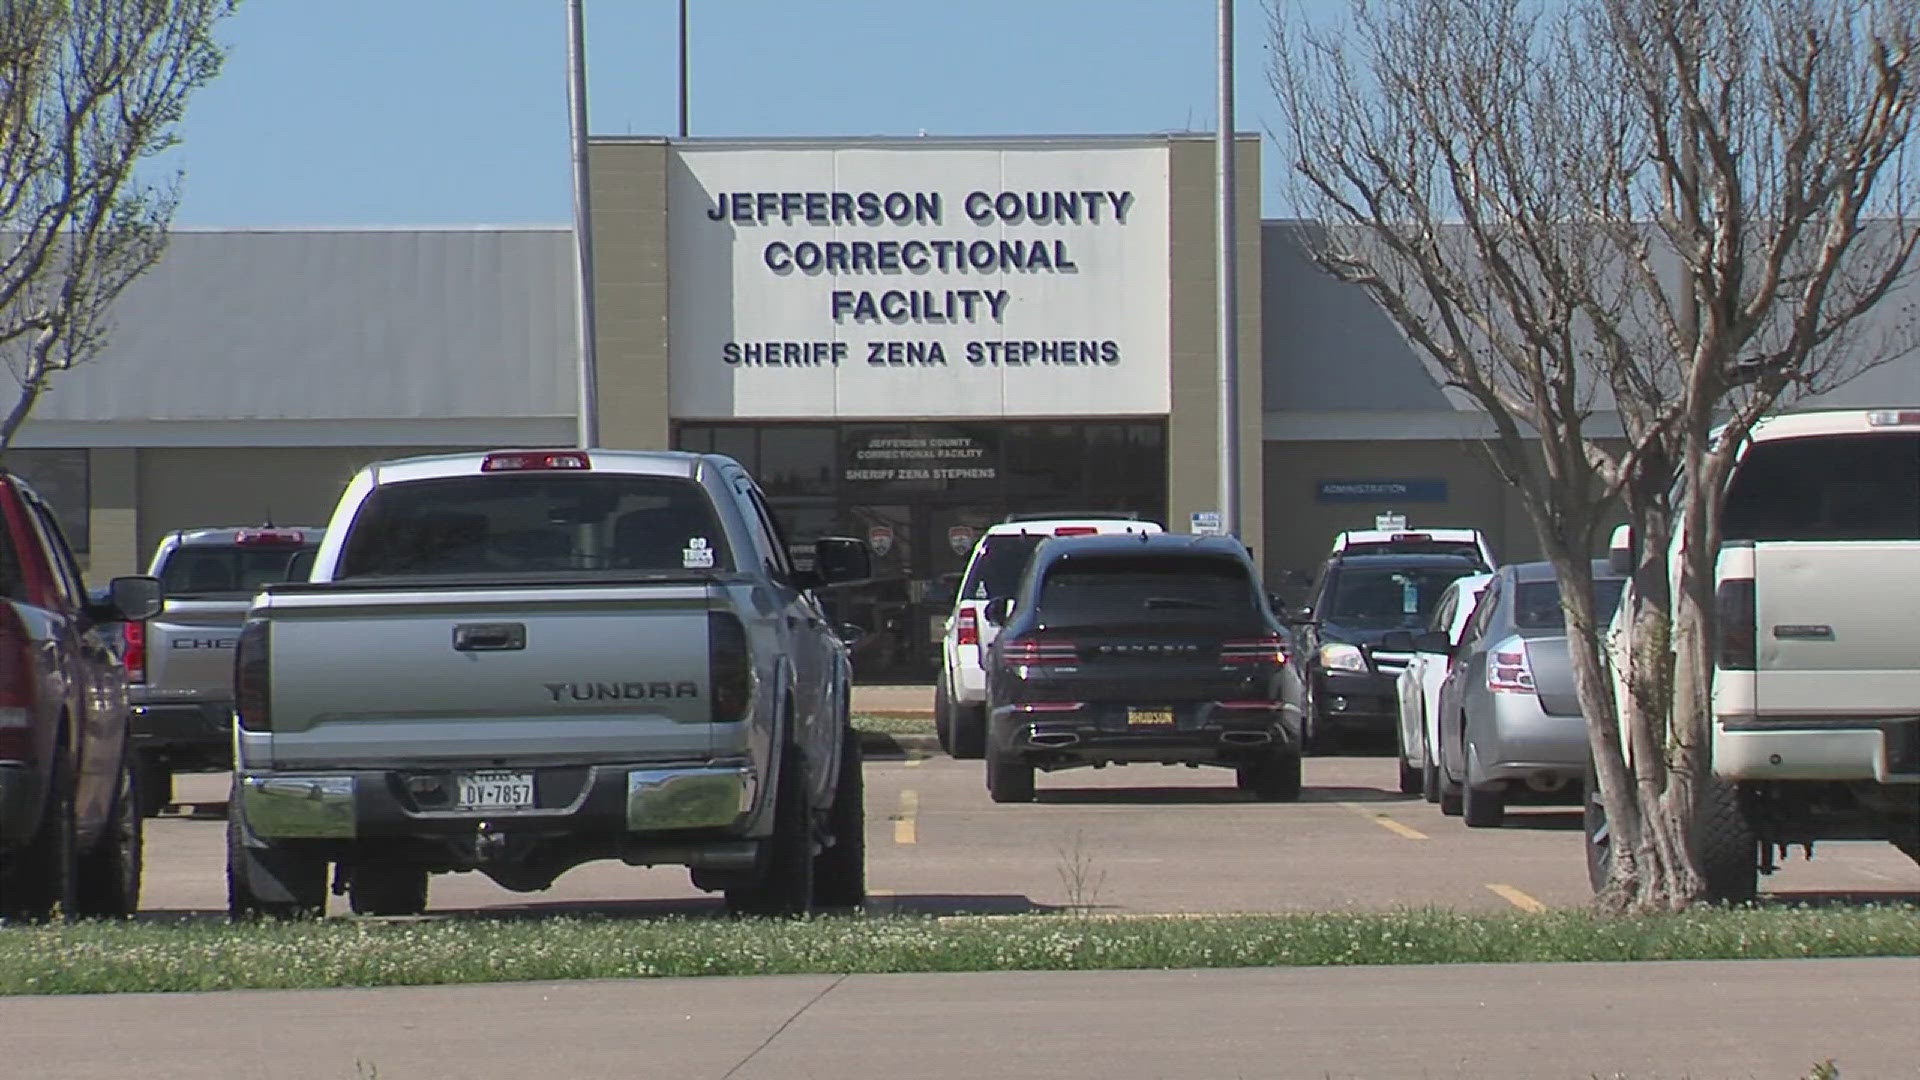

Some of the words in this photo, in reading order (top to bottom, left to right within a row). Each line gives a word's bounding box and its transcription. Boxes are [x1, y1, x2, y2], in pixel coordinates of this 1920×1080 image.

[707, 192, 941, 222] JEFFERSON
[964, 191, 1133, 220] COUNTY
[764, 240, 1075, 271] CORRECTIONAL
[832, 290, 1007, 320] FACILITY
[723, 342, 847, 365] SHERIFF
[867, 342, 946, 364] ZENA
[965, 341, 1119, 364] STEPHENS
[868, 438, 927, 448] JEFFERSON
[930, 438, 972, 447] COUNTY
[857, 449, 935, 459] CORRECTIONAL
[938, 449, 983, 458] FACILITY
[845, 469, 896, 480] SHERIFF
[898, 469, 930, 479] ZENA
[932, 468, 996, 479] STEPHENS
[1322, 484, 1407, 495] ADMINISTRATION
[689, 537, 707, 549] GO
[543, 681, 699, 701] TUNDRA
